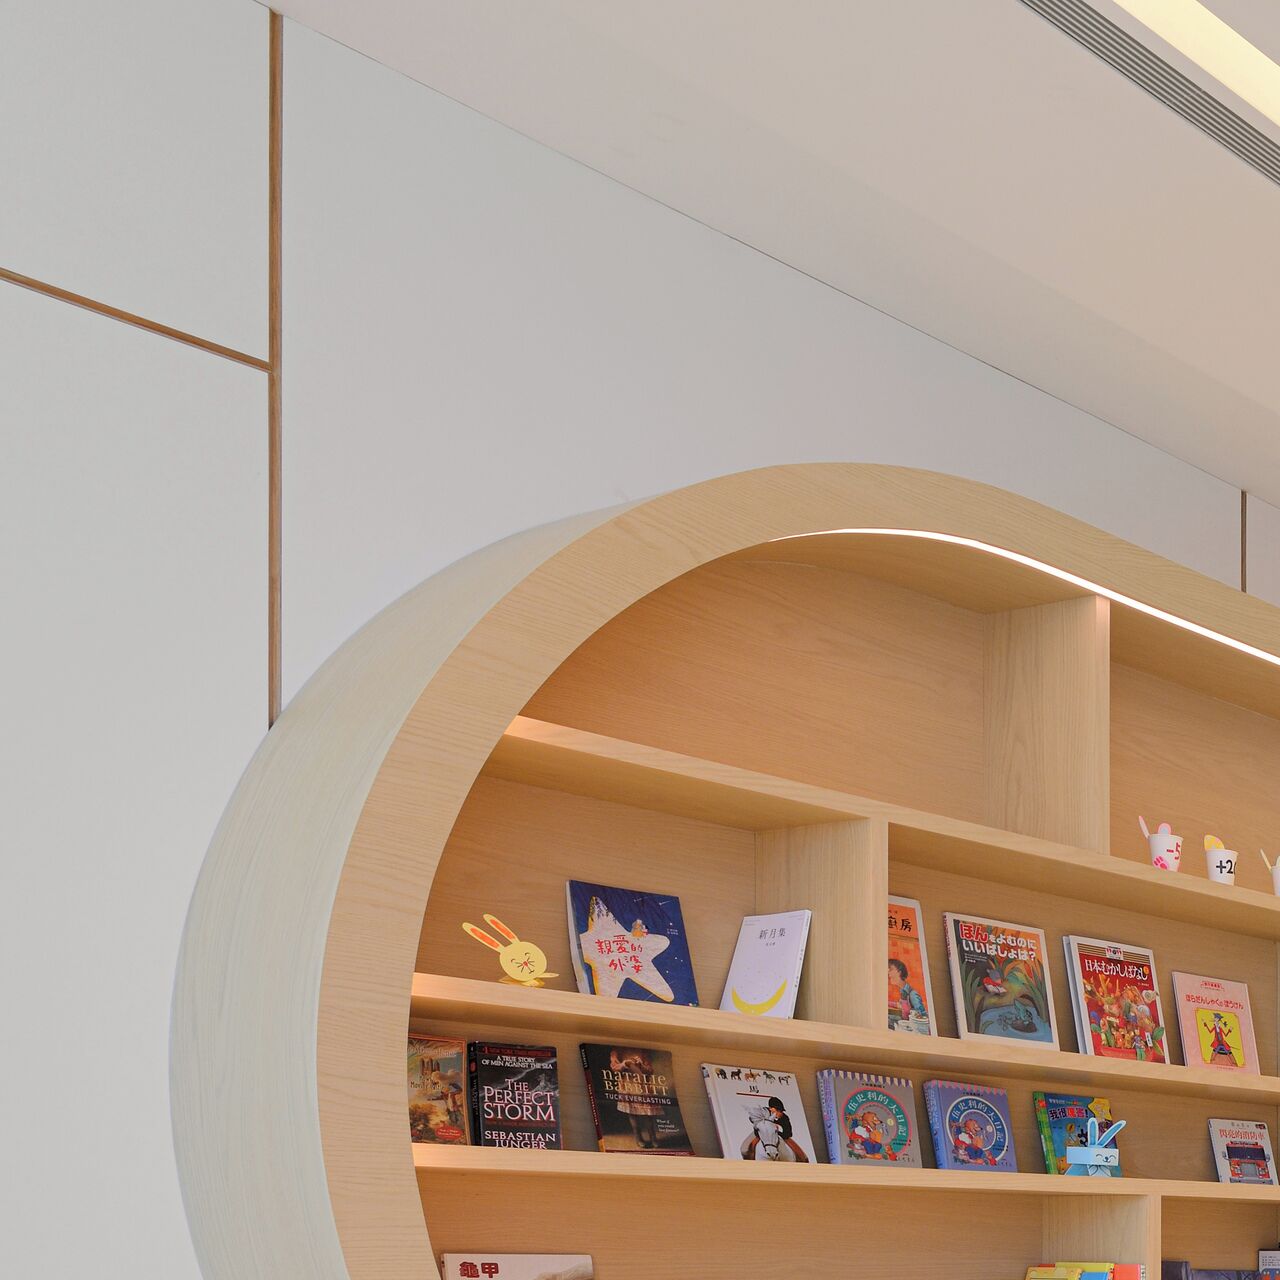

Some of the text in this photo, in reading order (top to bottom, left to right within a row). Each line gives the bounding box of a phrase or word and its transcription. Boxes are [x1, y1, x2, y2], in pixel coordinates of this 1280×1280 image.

[1215, 859, 1237, 875] +2
[595, 934, 643, 954] 親愛的
[959, 922, 1038, 949] ほんをよむのに
[609, 955, 643, 973] 外婆
[1084, 959, 1149, 981] 日本むかしばなし
[505, 1078, 529, 1091] THE
[483, 1086, 554, 1106] PERFECT
[625, 1095, 672, 1105] EVERLASTING
[484, 1103, 556, 1122] STORM
[484, 1131, 556, 1142] SEBASTIAN
[495, 1140, 548, 1150] JUNGER
[459, 1261, 500, 1279] 龜甲
